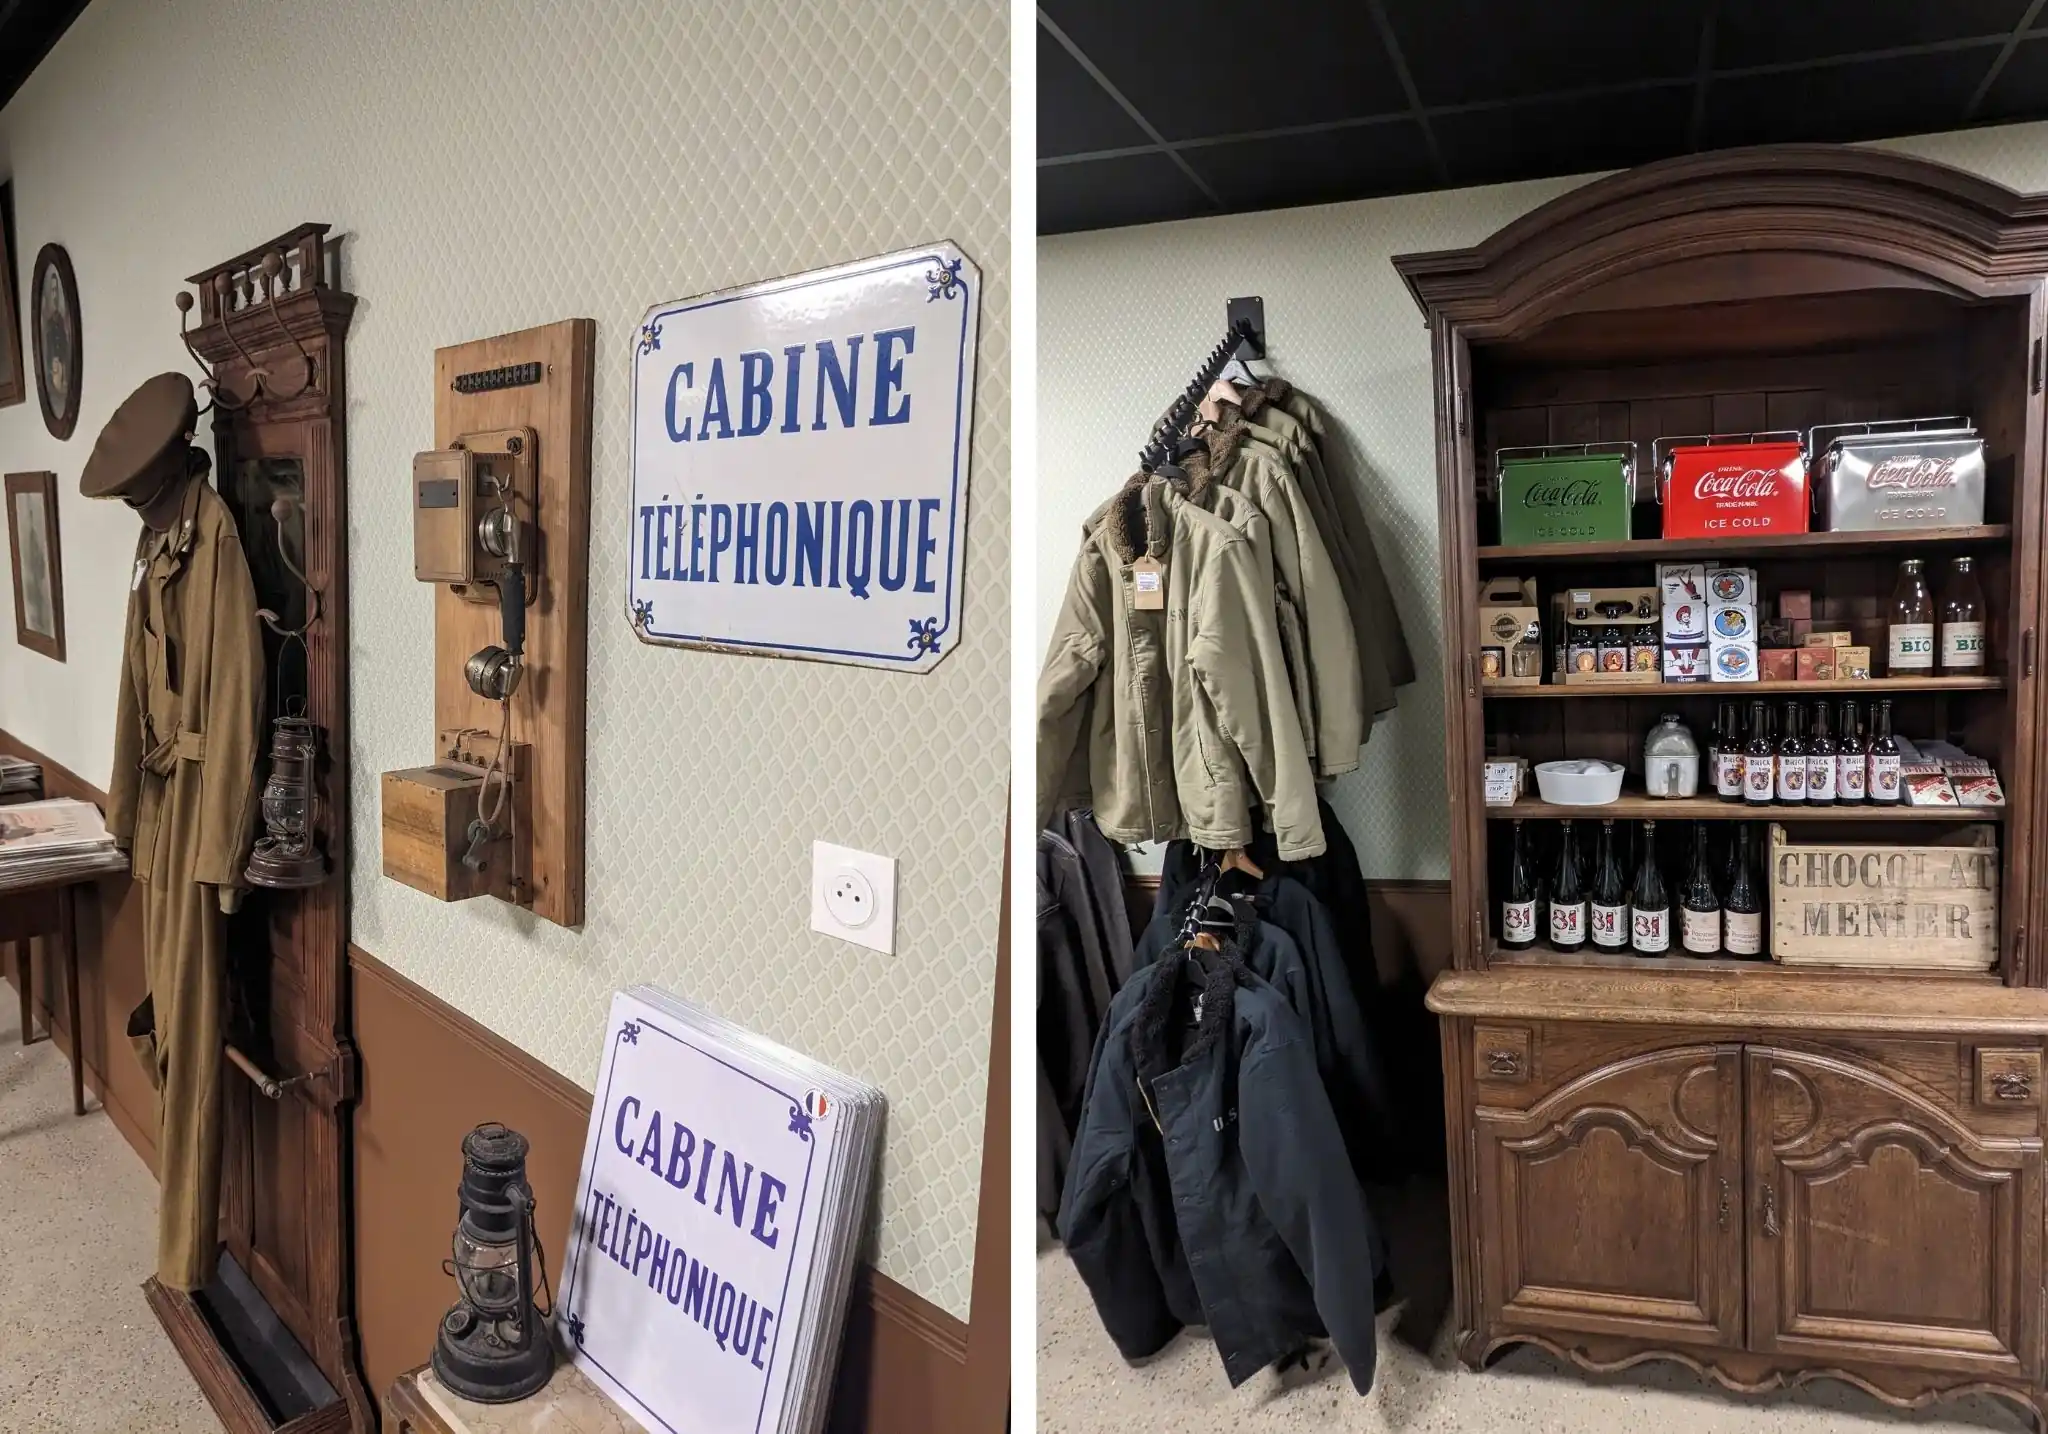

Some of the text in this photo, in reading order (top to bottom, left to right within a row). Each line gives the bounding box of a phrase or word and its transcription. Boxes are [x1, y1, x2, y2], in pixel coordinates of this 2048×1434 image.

[665, 325, 915, 443] CABINE
[1694, 469, 1778, 499] Coca-Cola
[1866, 457, 1957, 490] Coca-Cola
[1524, 480, 1602, 508] Coca-Cola
[1704, 517, 1772, 529] ICE COLD
[1904, 507, 1946, 519] COLD
[1560, 526, 1597, 536] COLD
[640, 494, 941, 600] TÉLÉPHONIQUE
[1901, 640, 1931, 653] BIO
[1956, 638, 1985, 651] BIO
[1779, 852, 1995, 892] CHOCOLAT
[1505, 908, 1530, 928] 81
[1552, 909, 1577, 930] 81
[1592, 909, 1614, 932] 81
[1635, 915, 1660, 938] 81
[1802, 902, 1973, 939] MENIER
[615, 1095, 787, 1250] CABINE
[588, 1188, 774, 1371] TÉLÉPHONIQUE
